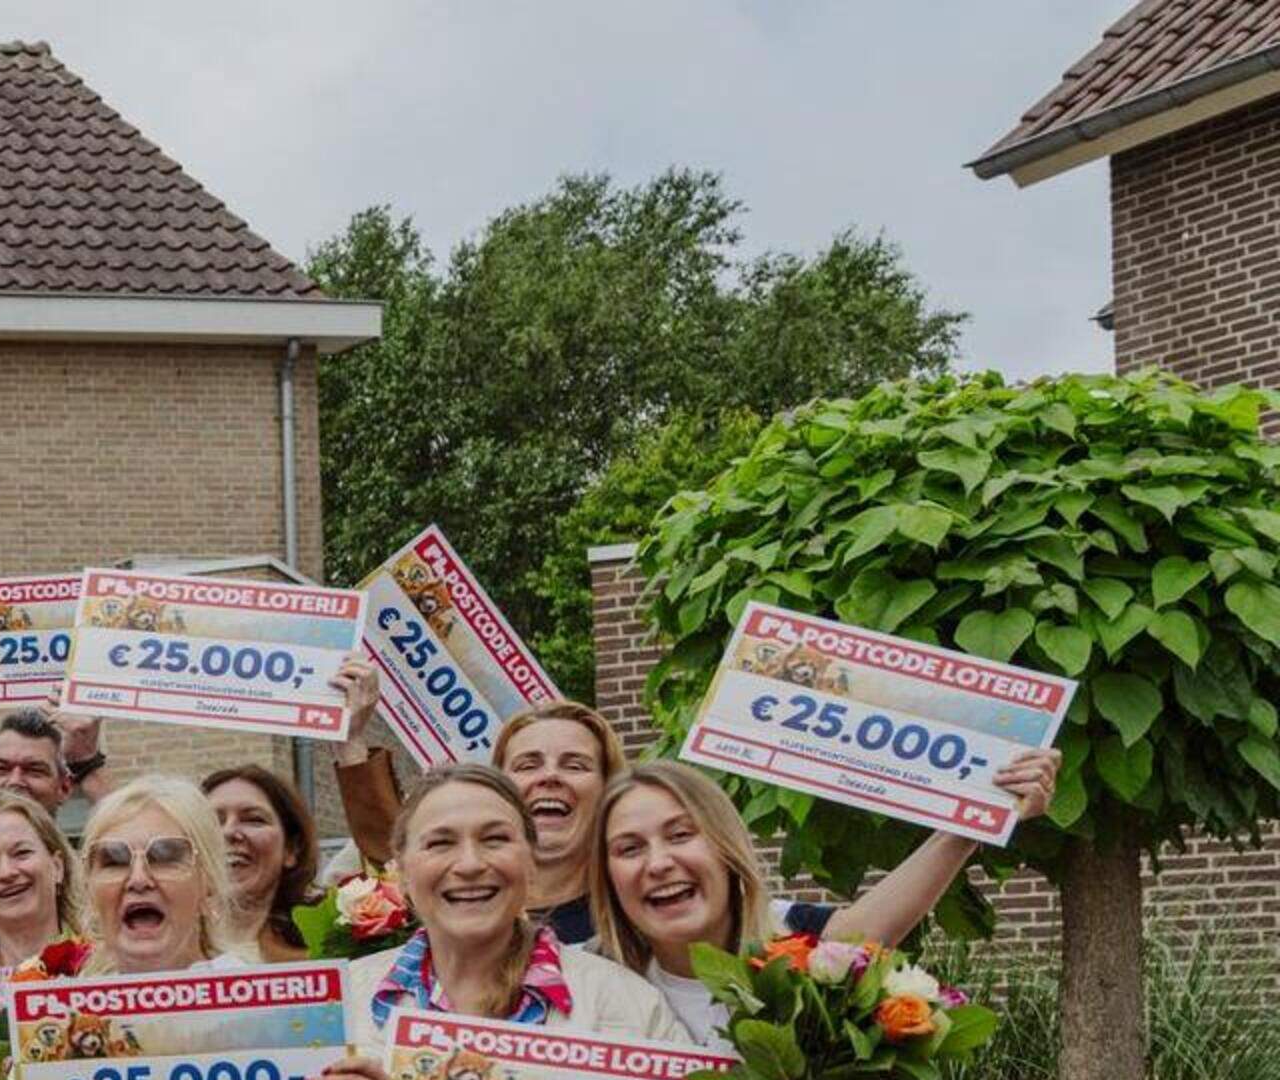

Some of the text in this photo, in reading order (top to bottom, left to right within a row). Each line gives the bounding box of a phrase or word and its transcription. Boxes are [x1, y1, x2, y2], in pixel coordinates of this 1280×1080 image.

[132, 579, 257, 607] POSTCODE
[259, 592, 350, 616] LOTERIJ
[136, 638, 315, 690] 25.000,-
[442, 572, 510, 661] POSTCODE
[506, 655, 546, 706] LOTE
[800, 628, 939, 678] POSTCODE
[941, 660, 1053, 706] LOTERIJ
[780, 694, 989, 781] 25.000,-
[70, 982, 211, 1013] POSTCODE
[216, 973, 329, 1003] LOTERIJ
[456, 1028, 607, 1069] POSTCODE
